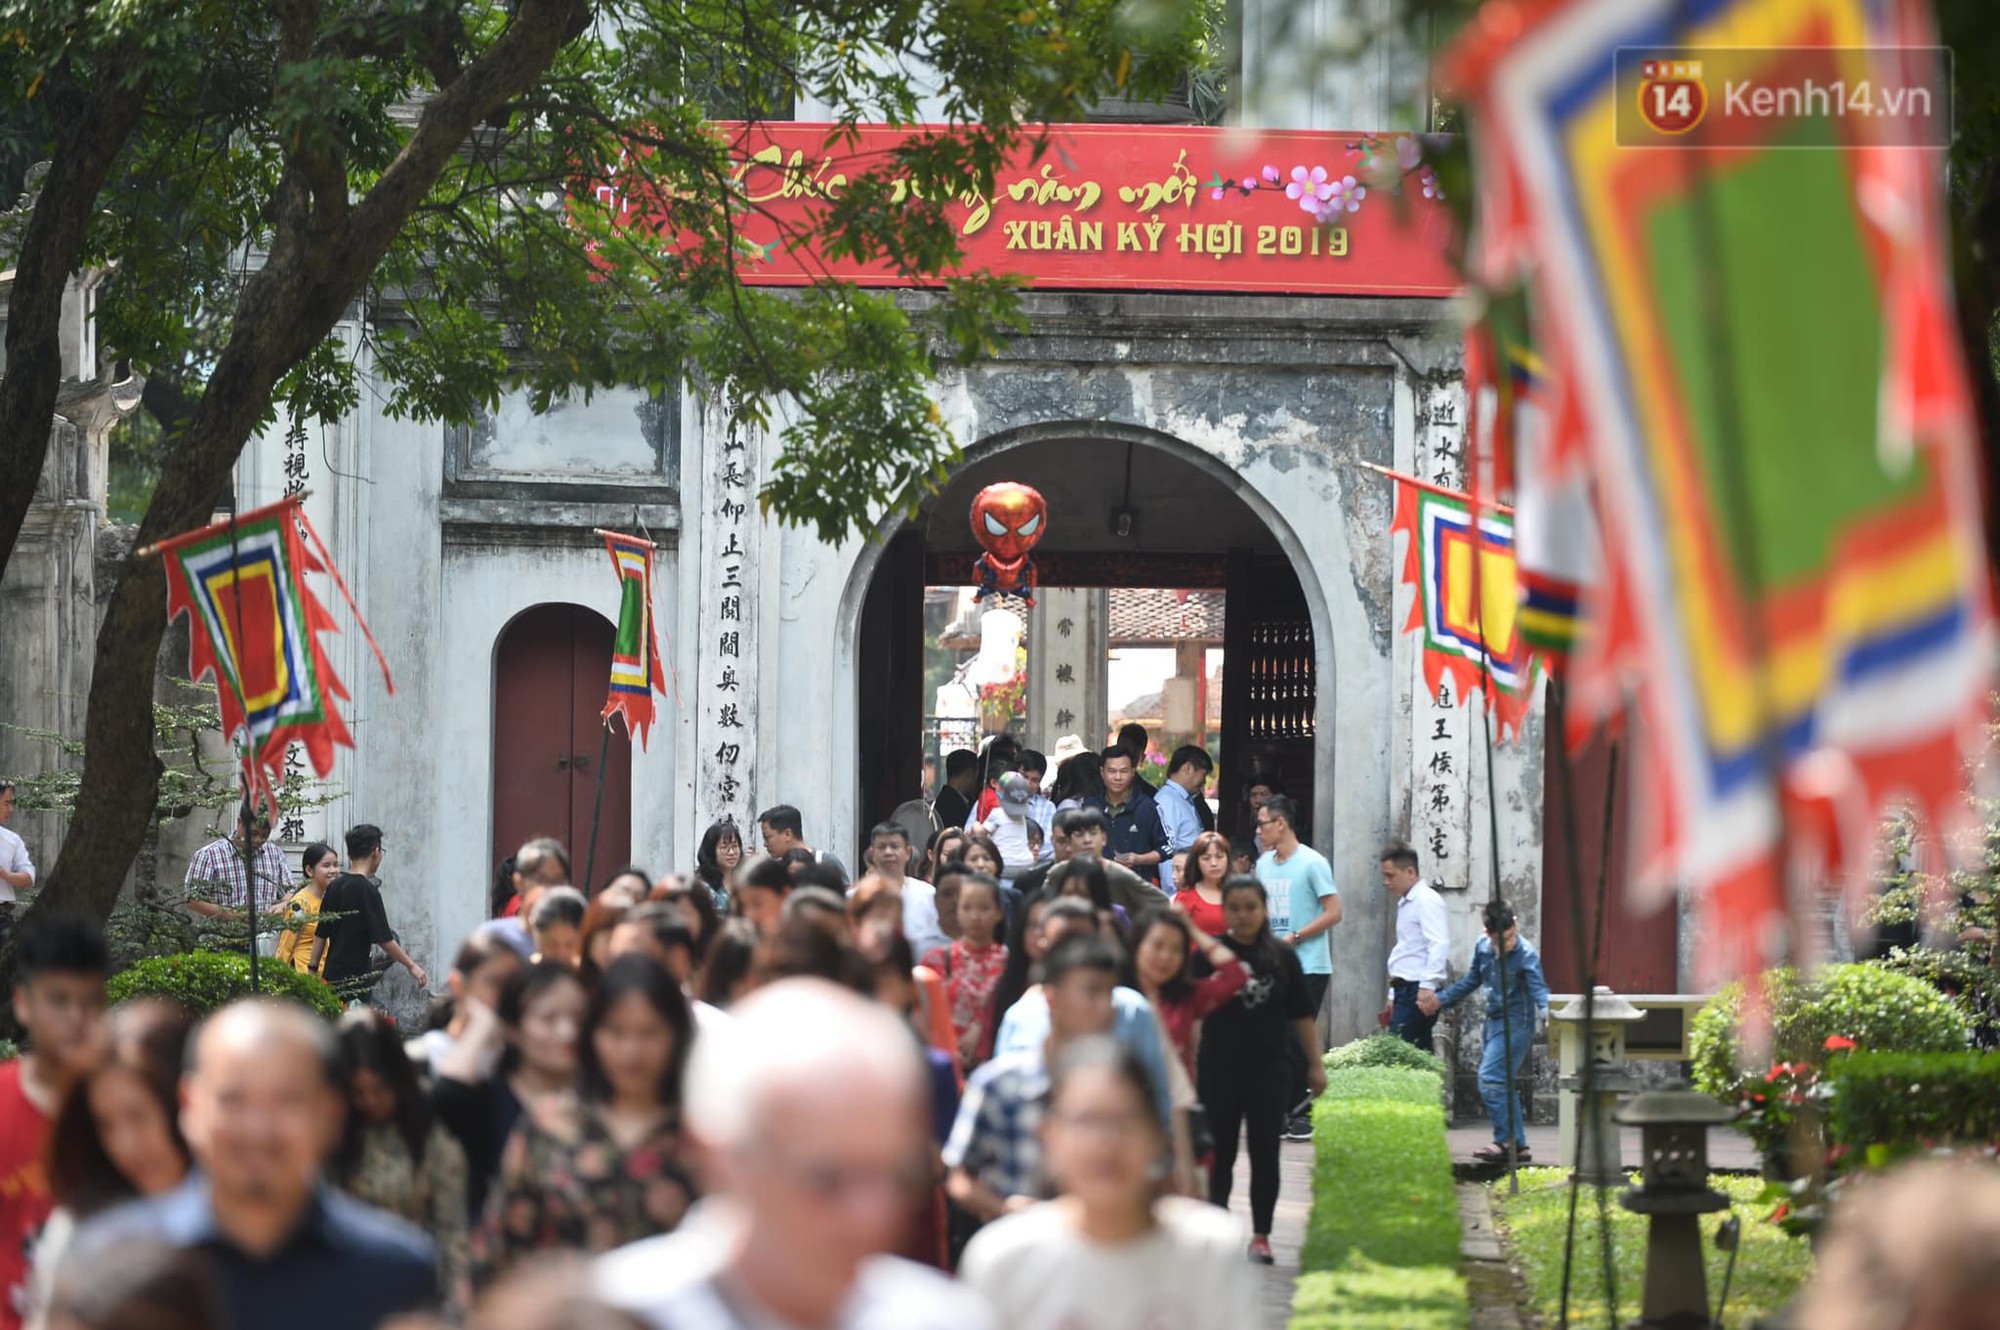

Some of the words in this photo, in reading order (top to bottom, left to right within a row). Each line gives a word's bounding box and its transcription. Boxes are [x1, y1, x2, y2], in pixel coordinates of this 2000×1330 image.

[1007, 162, 1102, 212] năm
[1118, 148, 1199, 212] mới
[1003, 214, 1103, 251] XUÂN
[1116, 214, 1166, 252] KỶ
[1175, 220, 1242, 260] HỢI
[1256, 224, 1349, 257] 2019
